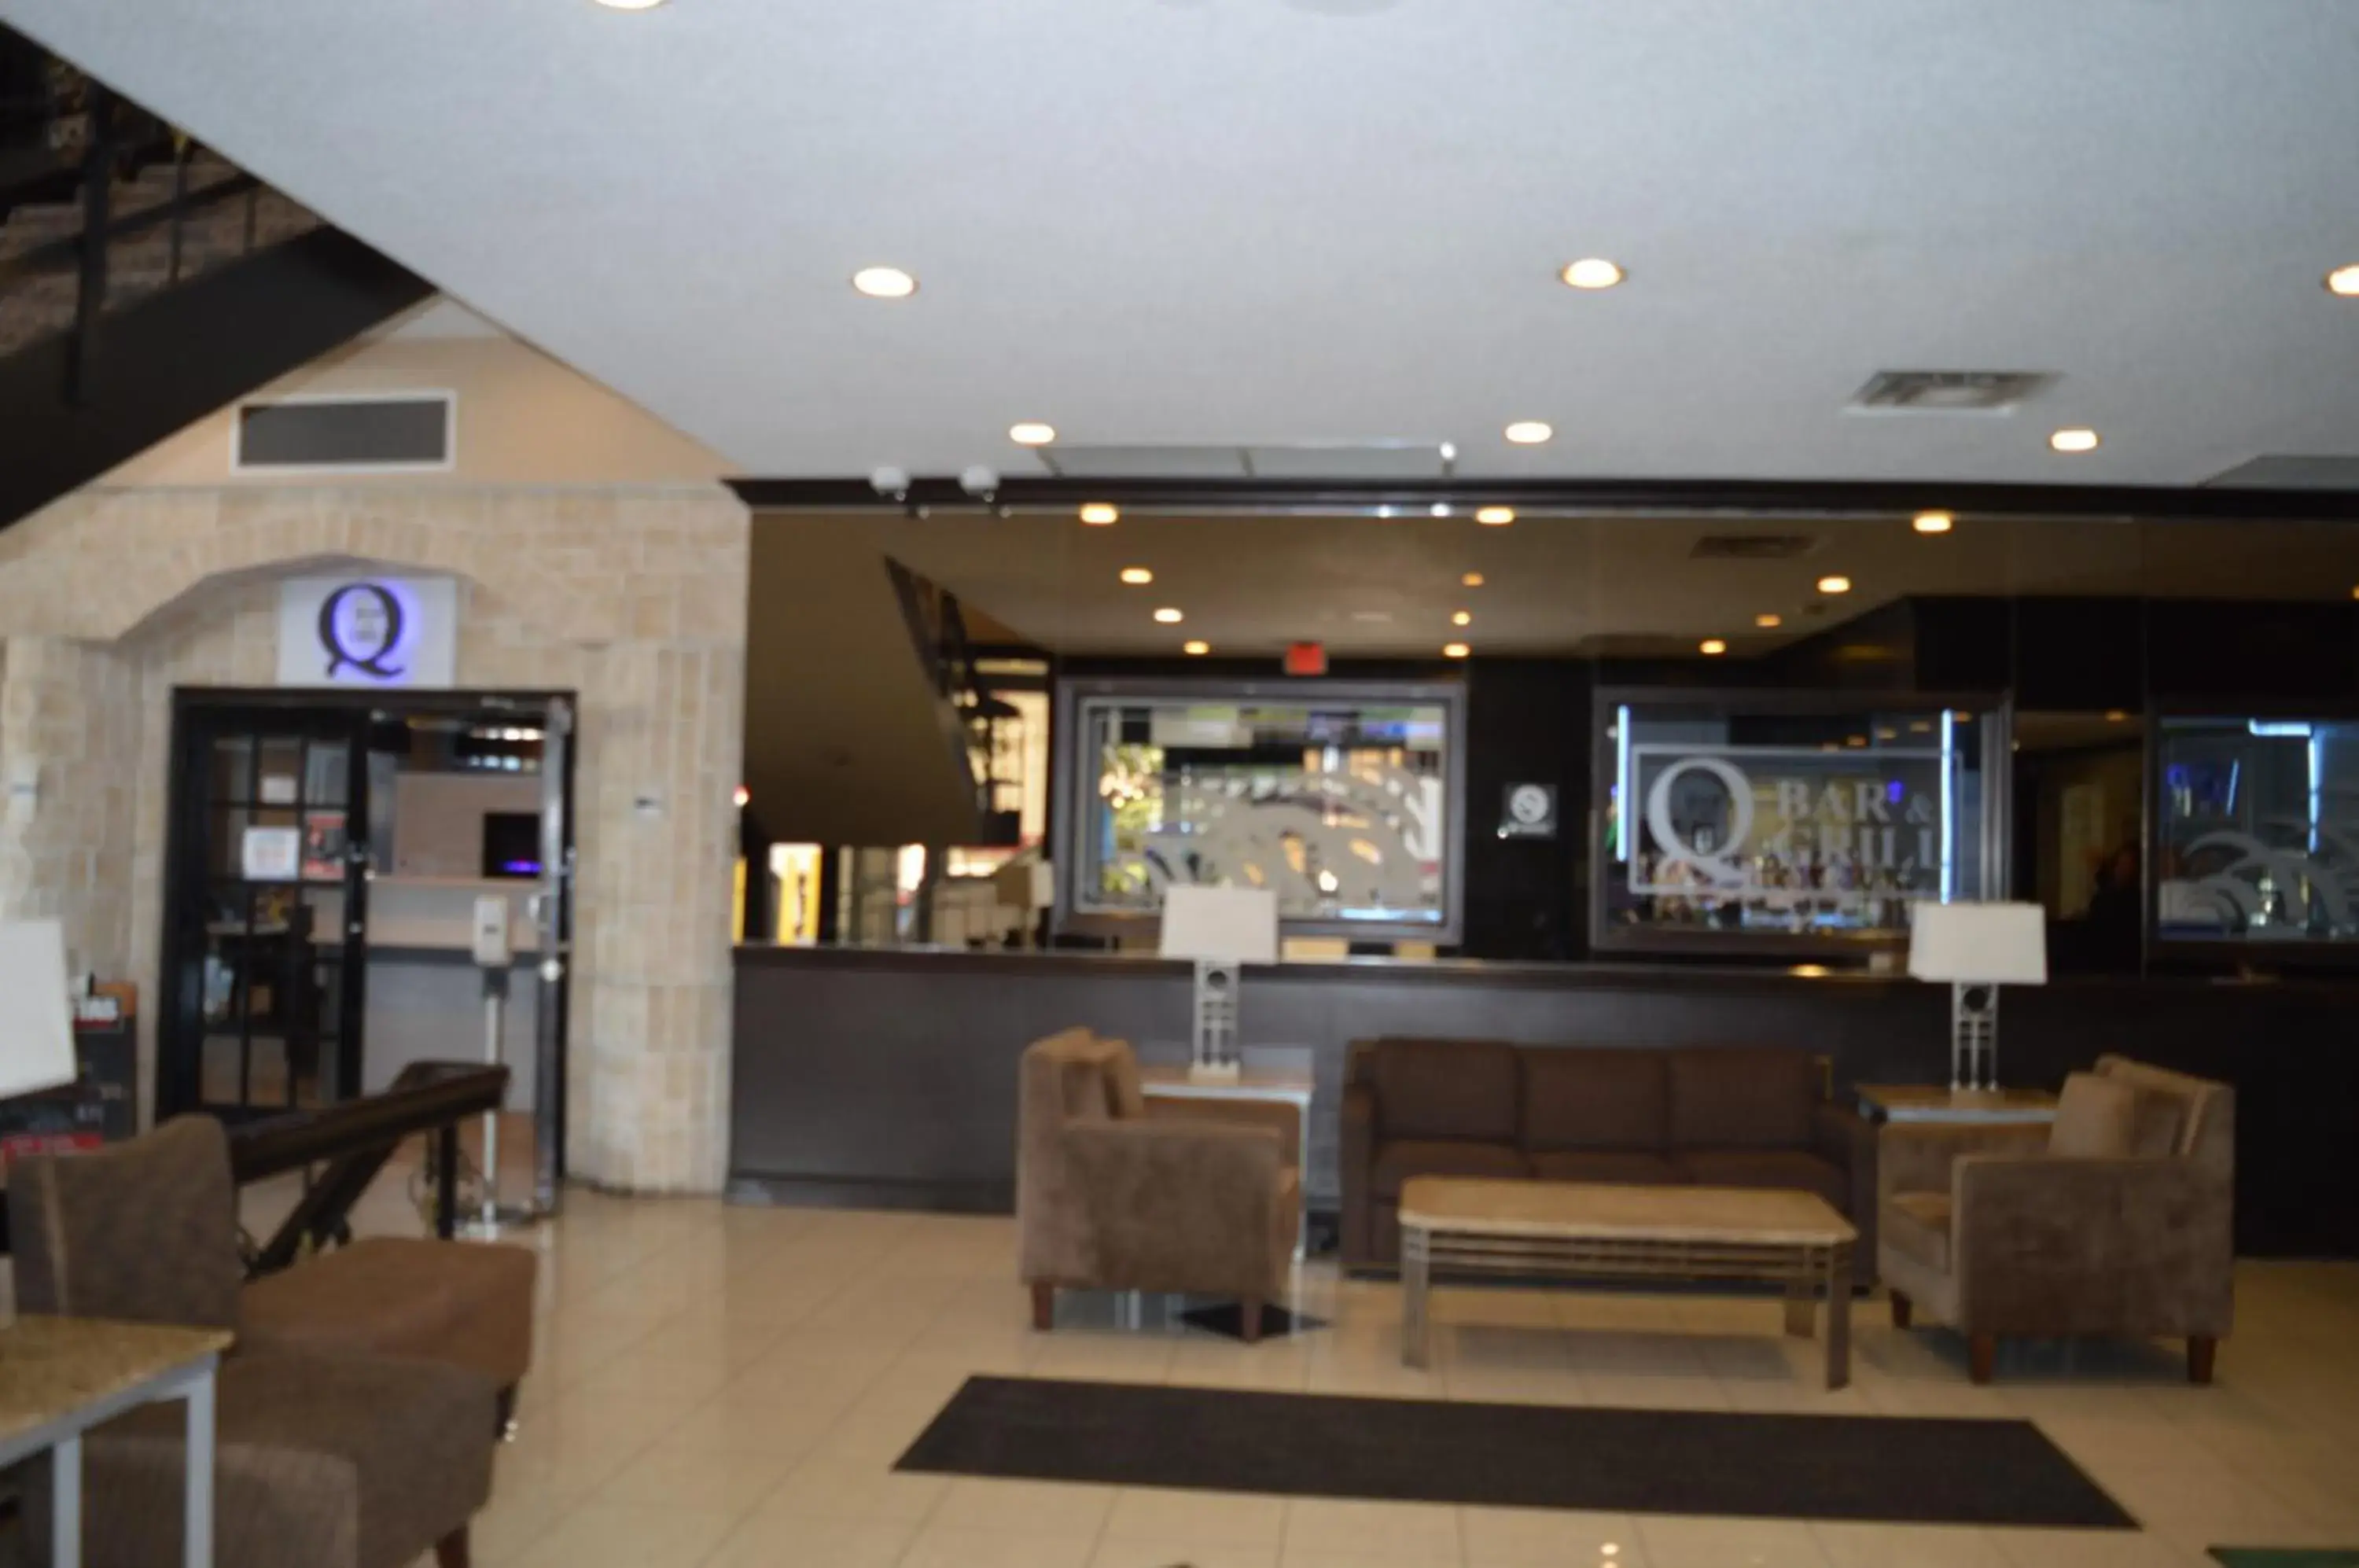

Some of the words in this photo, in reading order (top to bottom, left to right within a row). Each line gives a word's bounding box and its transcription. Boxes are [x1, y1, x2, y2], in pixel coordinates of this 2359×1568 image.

[318, 582, 406, 679] Q
[1647, 756, 1763, 890] Q
[1776, 776, 1891, 823] BAR
